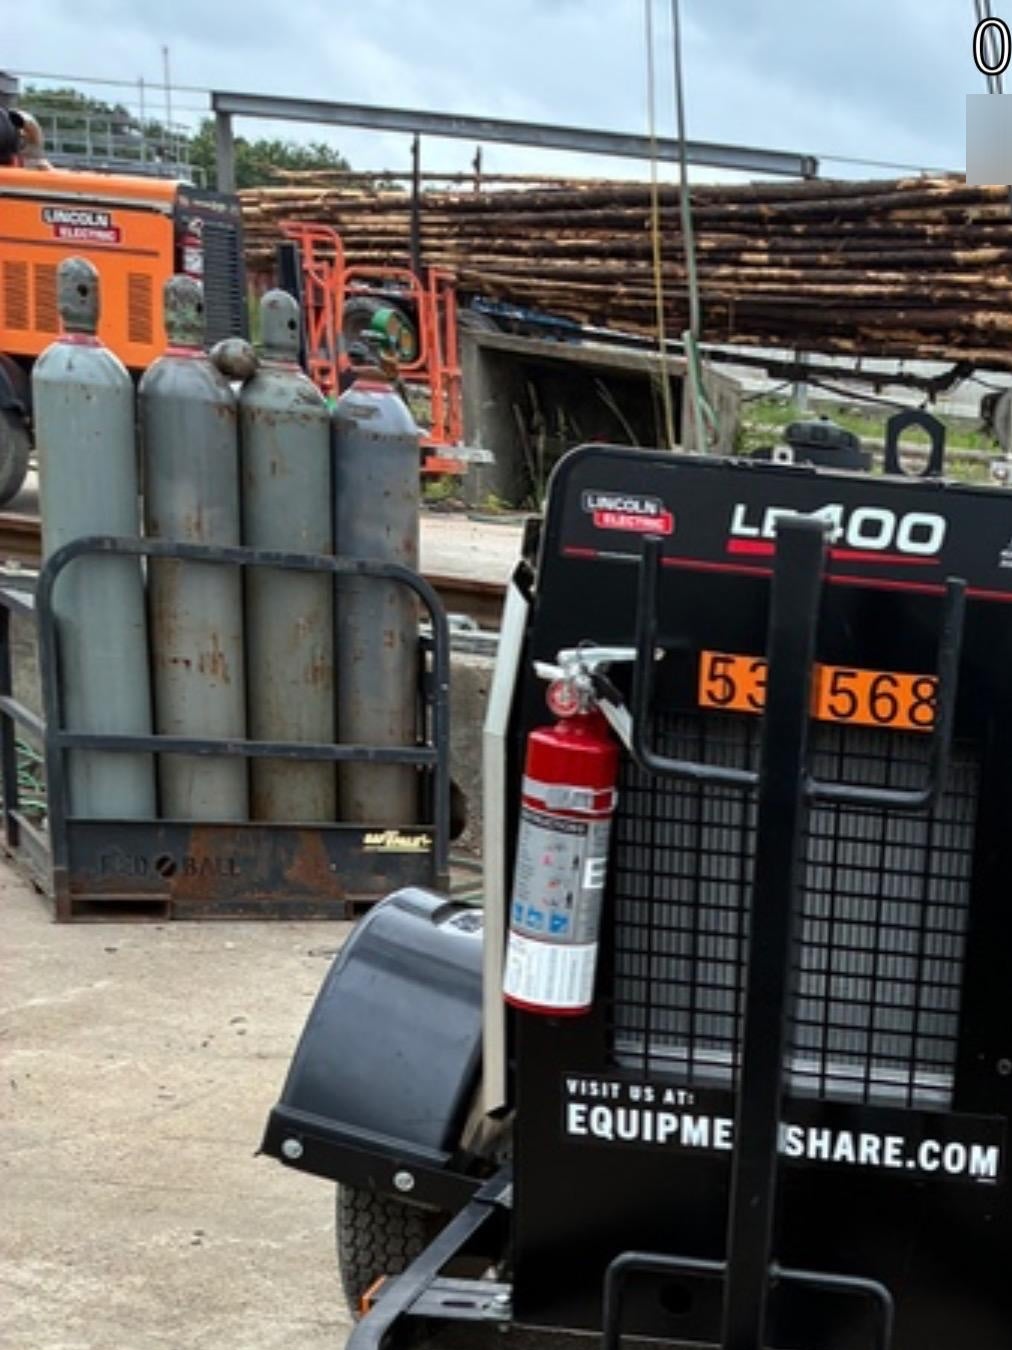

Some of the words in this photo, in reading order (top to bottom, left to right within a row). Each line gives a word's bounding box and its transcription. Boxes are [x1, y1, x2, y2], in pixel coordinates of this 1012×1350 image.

[45, 208, 109, 226] LINCOLN
[587, 494, 658, 515] LINCOLN
[707, 656, 936, 727] 53568
[566, 1079, 621, 1099] VISIT
[629, 1084, 655, 1102] US
[662, 1088, 695, 1105] AT:
[568, 1102, 999, 1177] EQUIPMESHARE.COM
